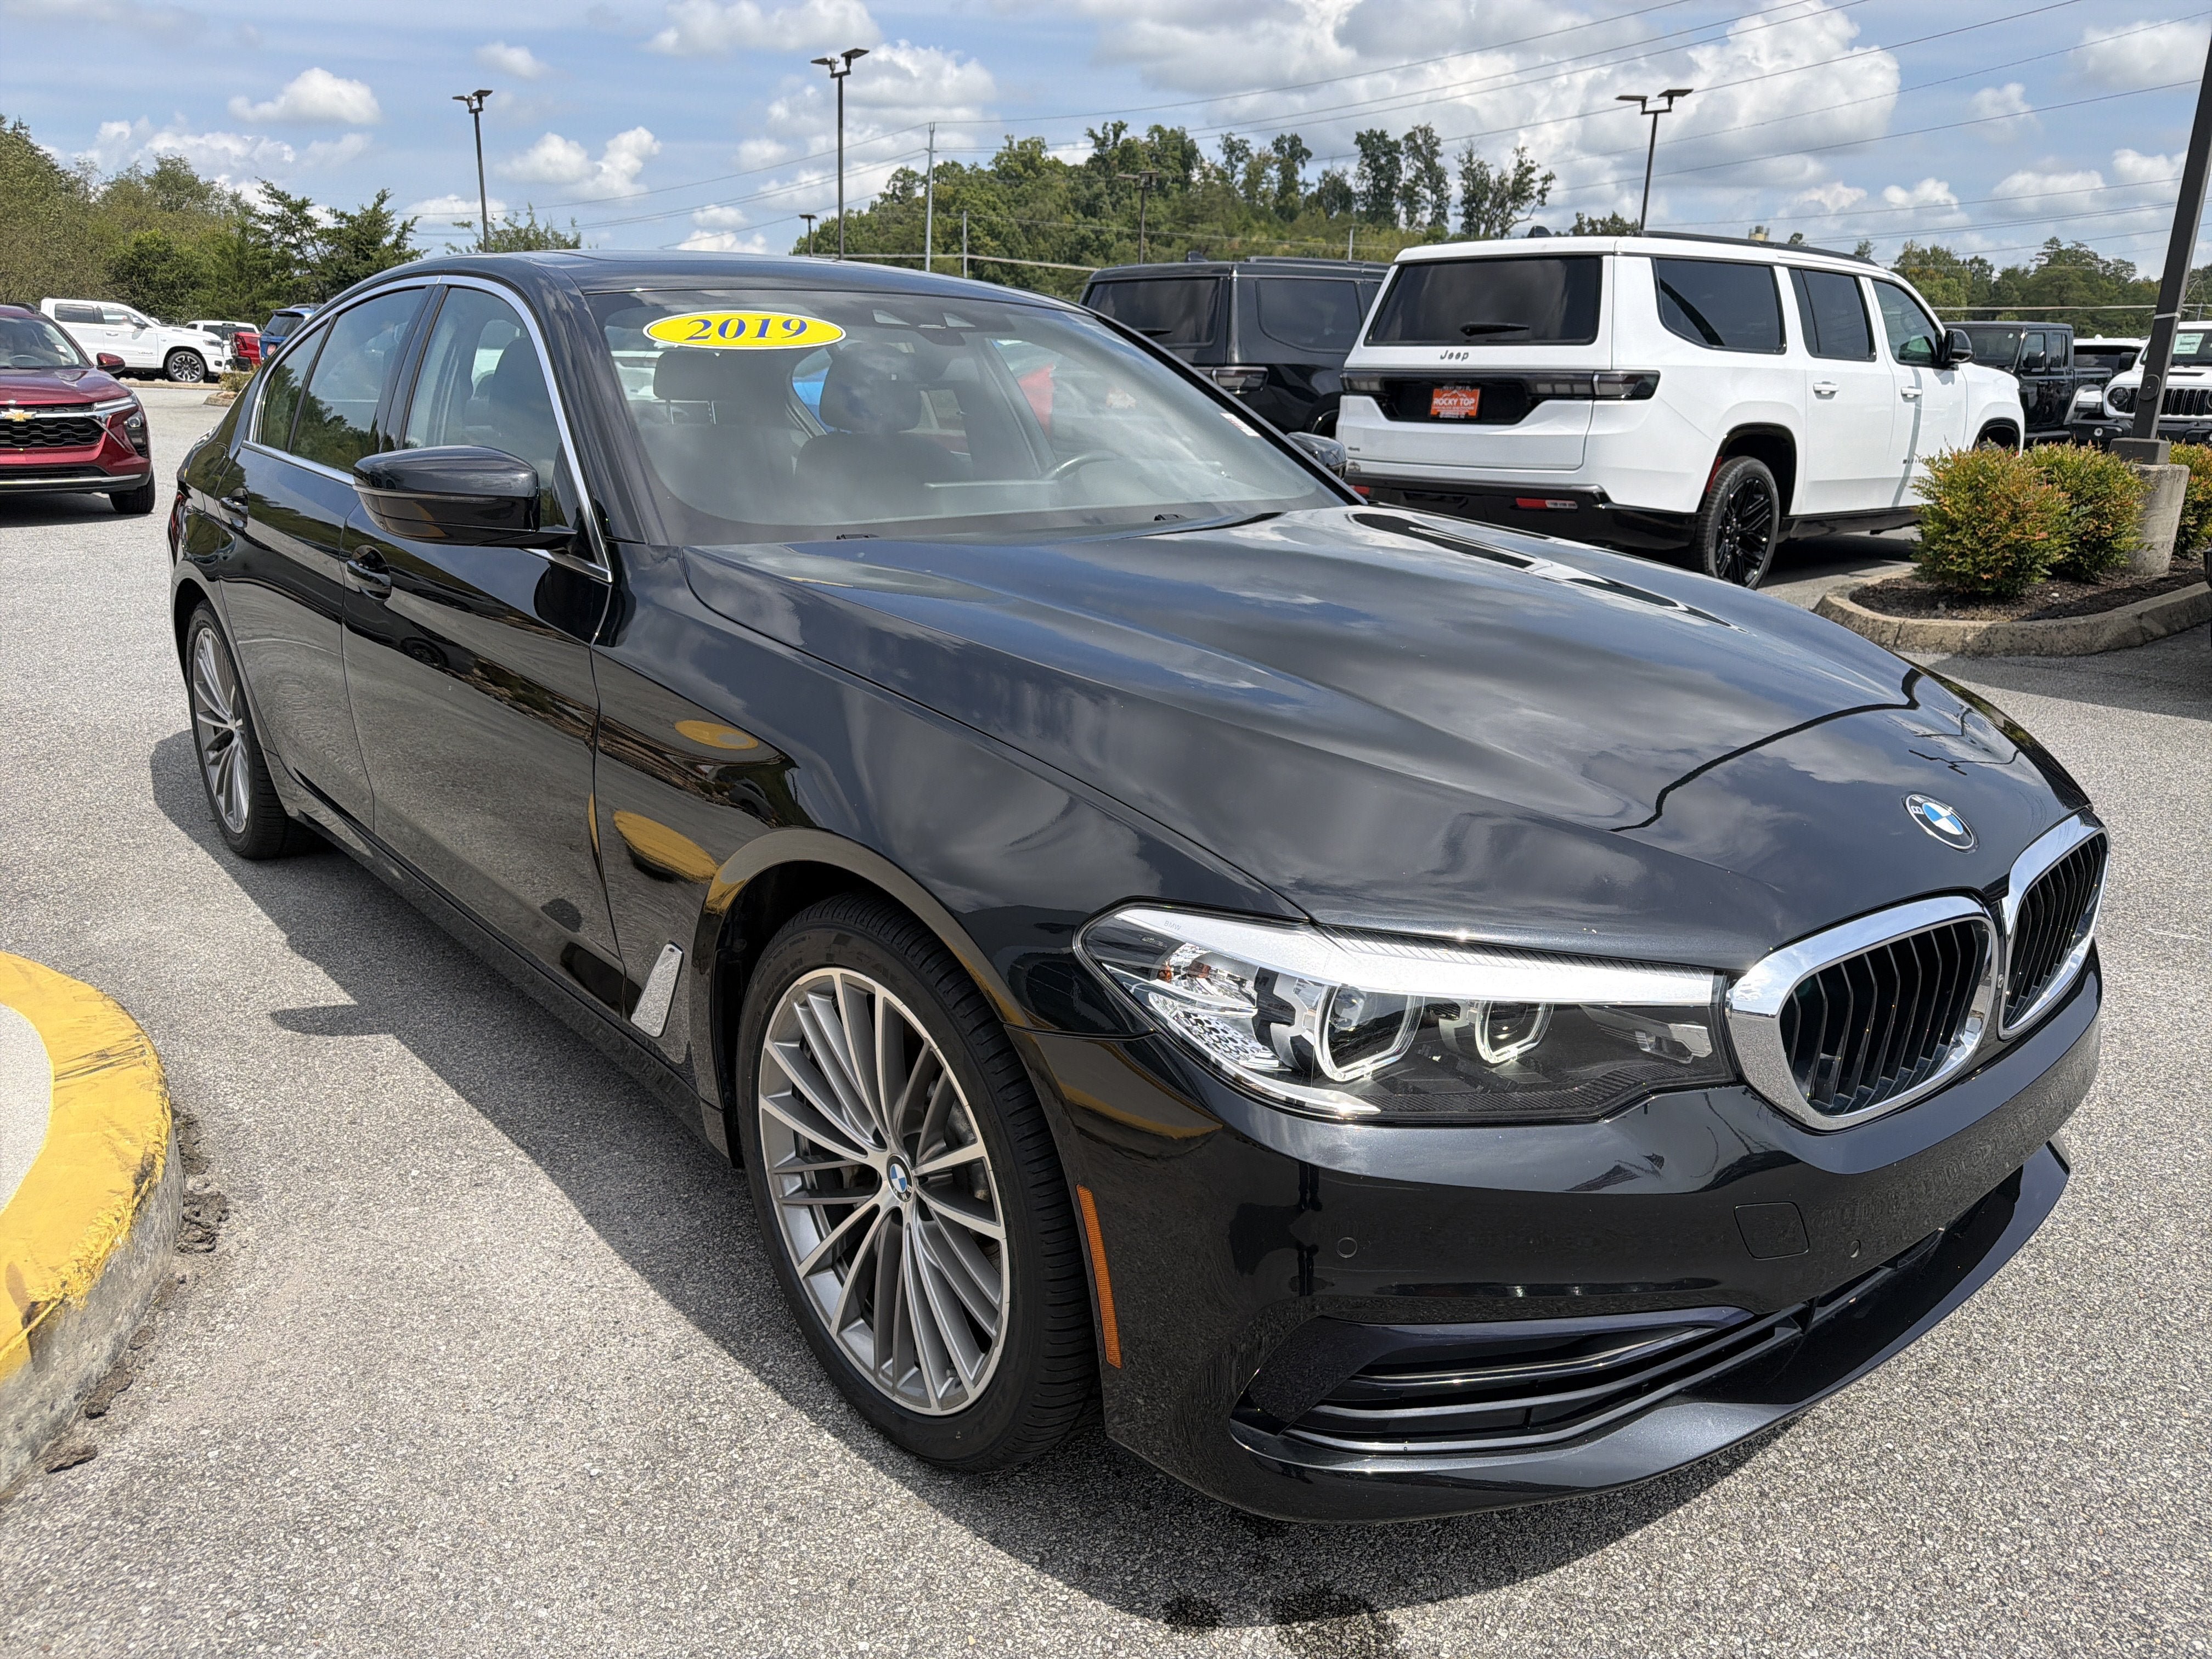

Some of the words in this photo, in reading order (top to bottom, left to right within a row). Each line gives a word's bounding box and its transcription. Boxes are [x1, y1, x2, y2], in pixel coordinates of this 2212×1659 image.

[684, 318, 808, 341] 2019
[1440, 349, 1469, 362] Jeep
[1434, 397, 1458, 406] ROCKY
[1459, 398, 1475, 406] TOP
[1164, 920, 1182, 931] BMW
